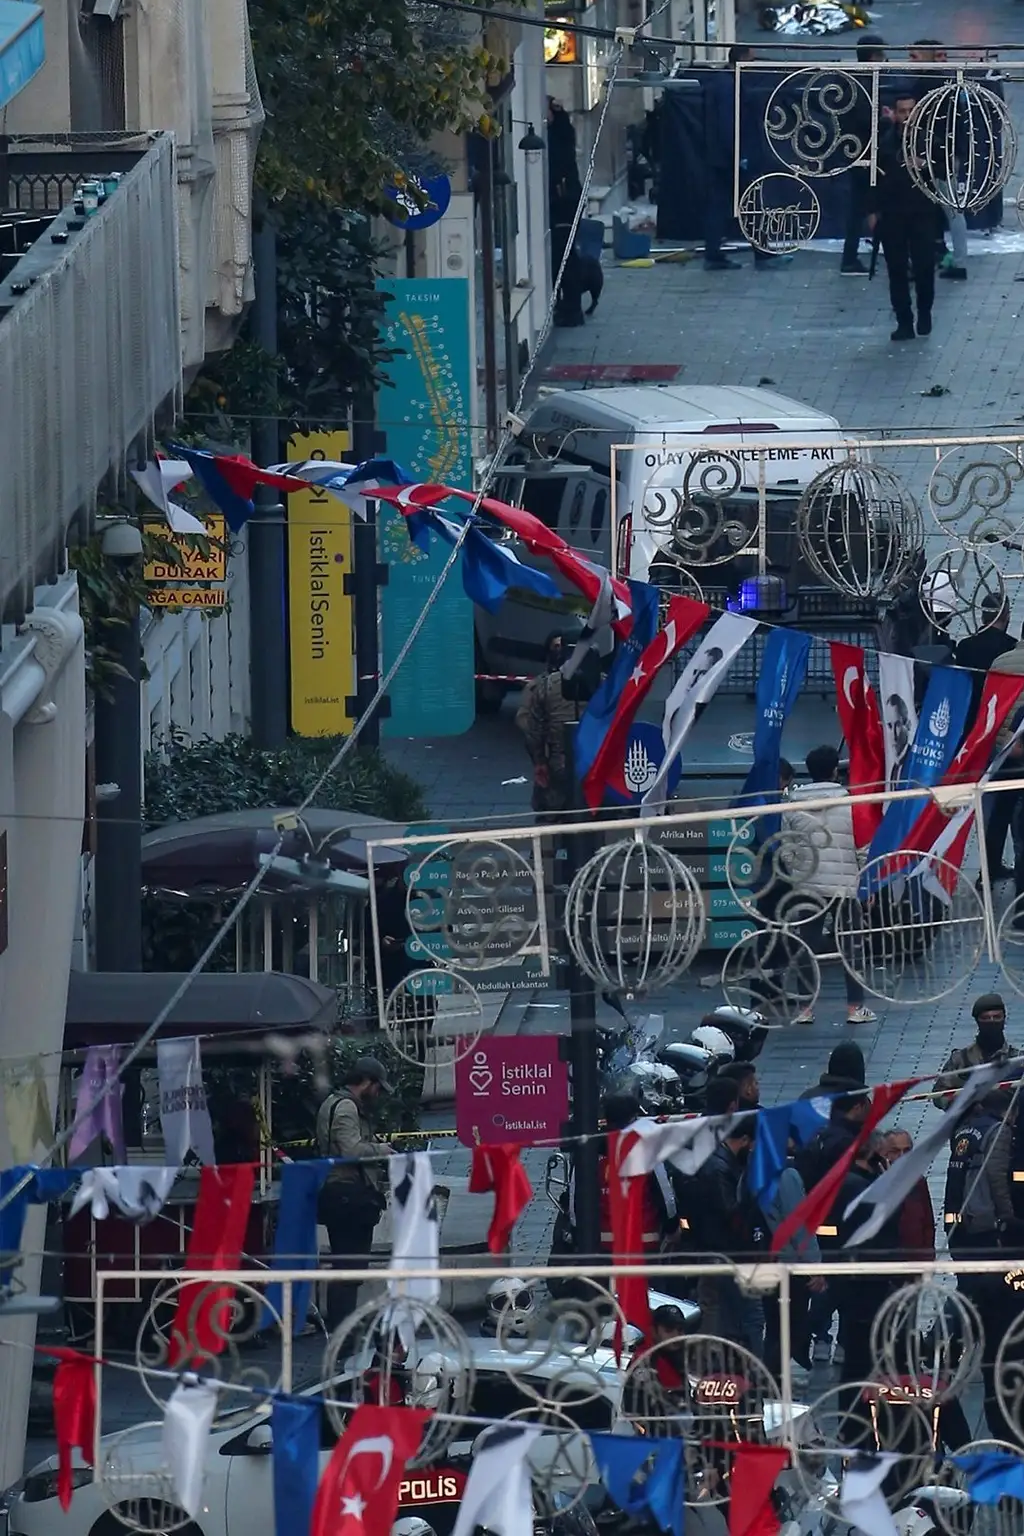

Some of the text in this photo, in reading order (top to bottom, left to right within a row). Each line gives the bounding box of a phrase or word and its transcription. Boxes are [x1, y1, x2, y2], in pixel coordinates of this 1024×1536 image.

[645, 452, 684, 467] OLAY
[153, 566, 219, 578] DURAK
[660, 830, 684, 839] Afrika
[686, 830, 704, 839] Han
[477, 981, 511, 991] Abdullah
[501, 1081, 547, 1096] Senin
[505, 1120, 547, 1130] istiklal.ist
[697, 1379, 737, 1397] POLİS
[397, 1475, 457, 1501] POLİS
